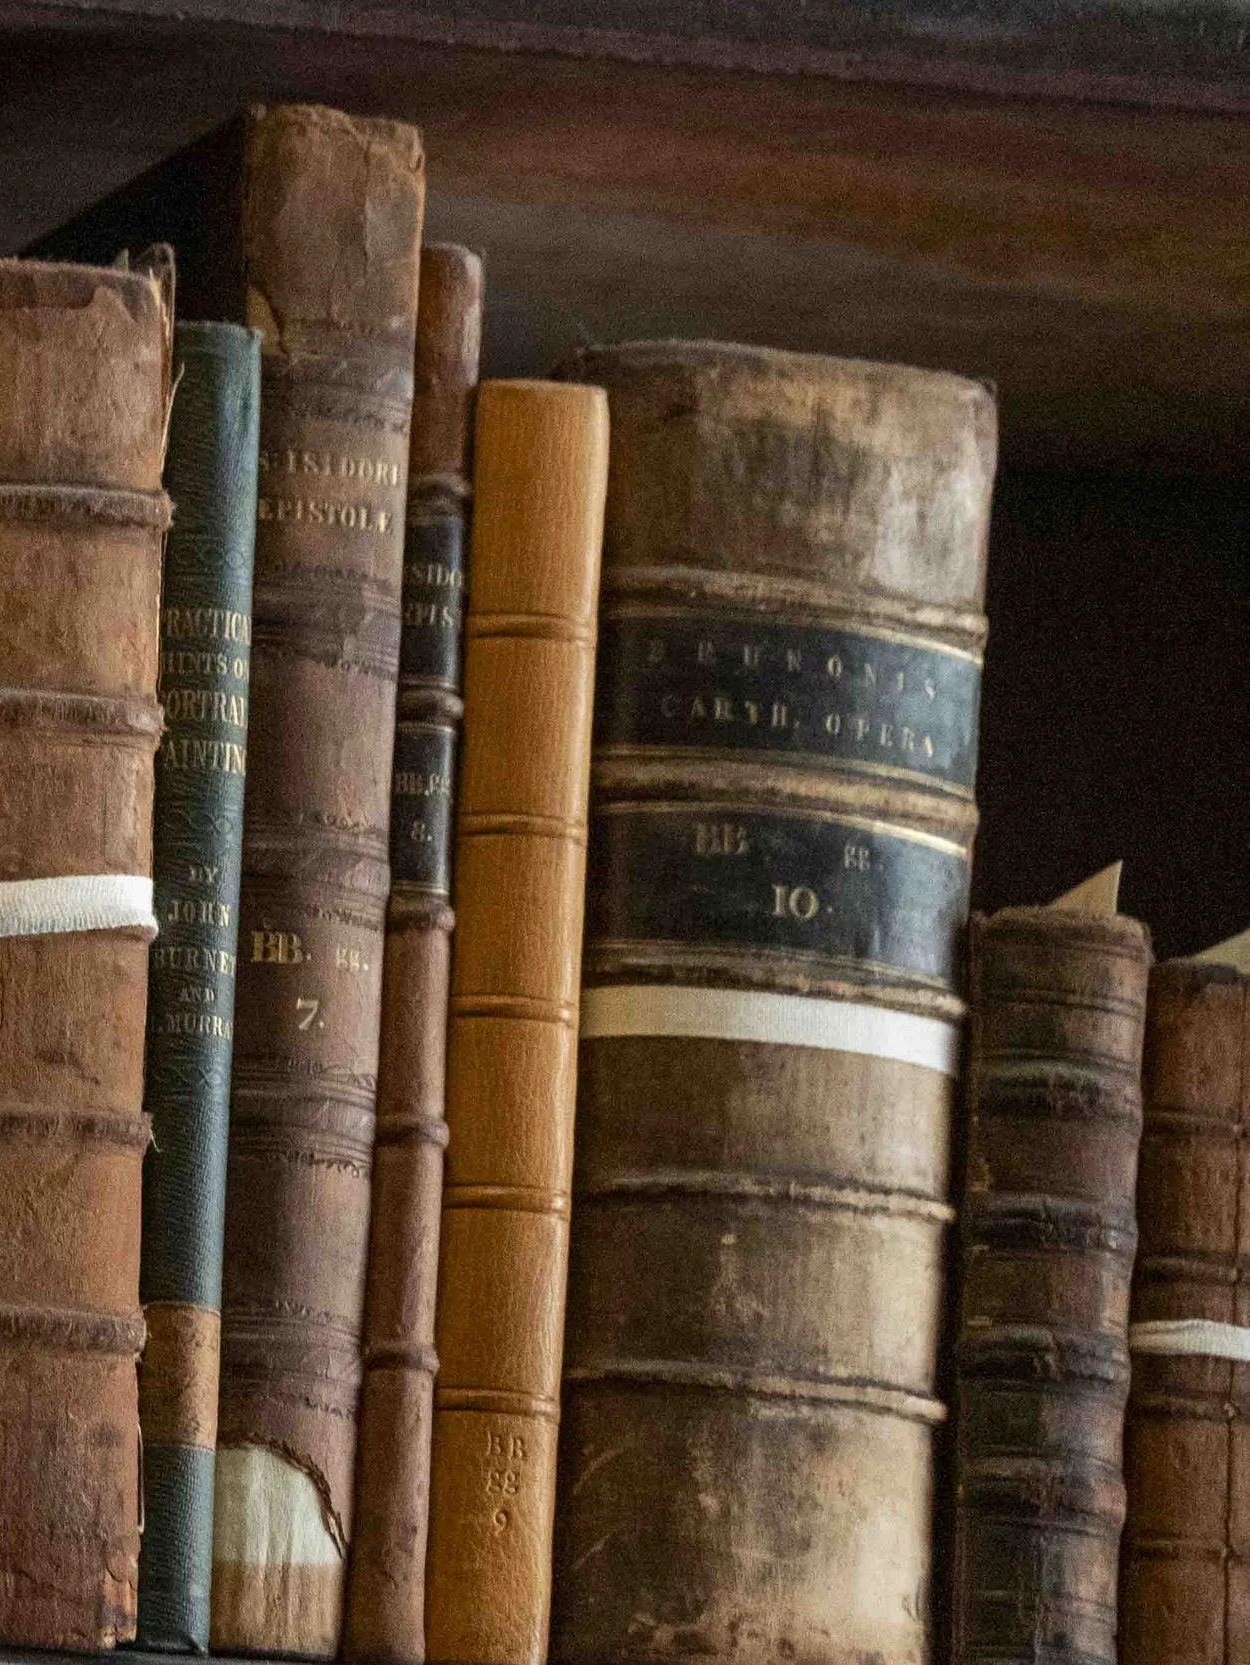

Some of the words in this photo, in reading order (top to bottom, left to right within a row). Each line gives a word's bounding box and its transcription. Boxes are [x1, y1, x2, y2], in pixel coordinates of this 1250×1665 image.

[161, 607, 251, 646] RACTICA
[160, 688, 248, 729] ORTRAI
[825, 708, 935, 759] OPERA
[162, 738, 246, 777] AINTIN
[153, 947, 237, 978] BURNE
